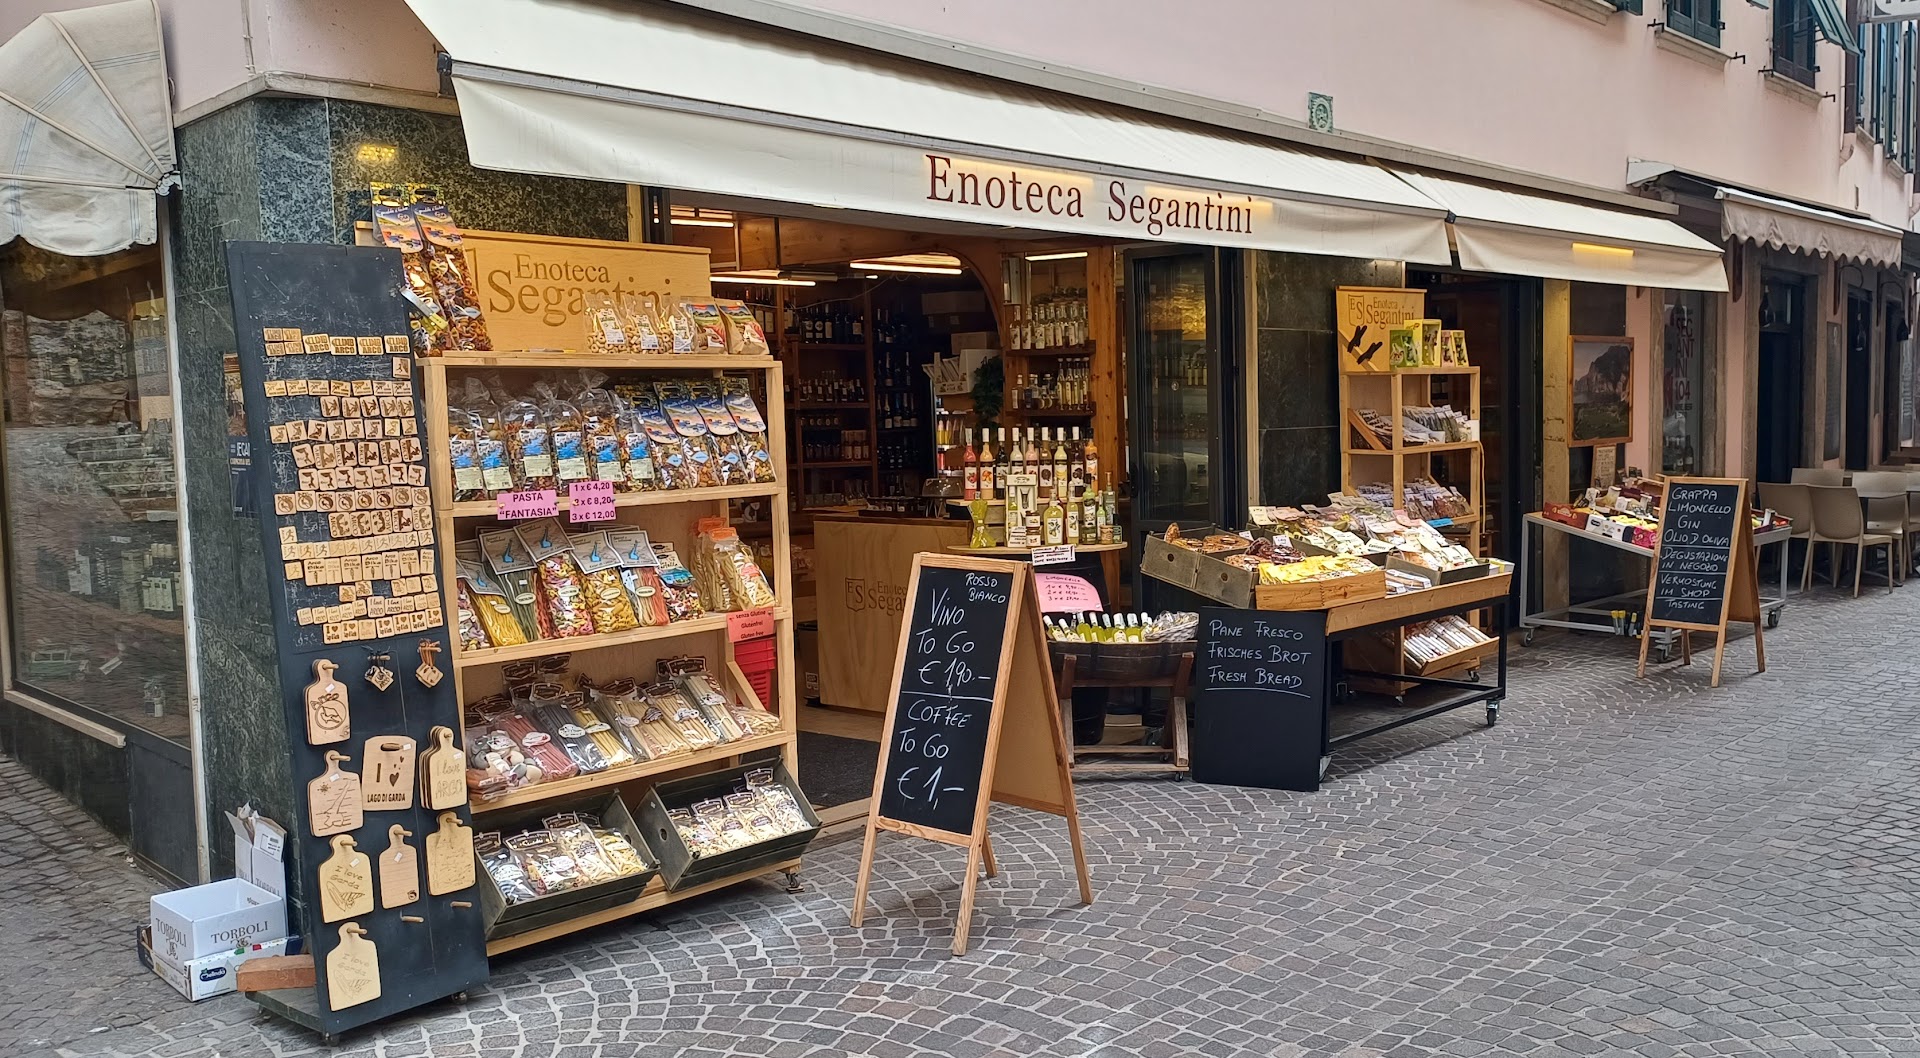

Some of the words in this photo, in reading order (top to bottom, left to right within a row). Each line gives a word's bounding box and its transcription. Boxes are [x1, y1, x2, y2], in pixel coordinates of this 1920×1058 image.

[925, 154, 1084, 218] Enoteca
[1108, 181, 1252, 236] Segantini
[514, 253, 611, 283] Enoteca
[487, 270, 671, 326] Segatn
[593, 482, 610, 491] 4,20
[1671, 487, 1717, 500] GRAPPA
[513, 492, 543, 502] PASTA
[593, 497, 611, 505] 8,20
[593, 511, 615, 519] 12,00
[1668, 501, 1731, 514] LIMONCELLO
[1678, 515, 1700, 529] GIN
[1701, 534, 1729, 547] OLIVA
[965, 572, 998, 587] ROSSO
[877, 581, 907, 596] Enotec
[968, 587, 1006, 604] BIANCO
[1681, 588, 1710, 598] SHOP
[931, 588, 965, 626] VINO
[1665, 599, 1704, 609] TASTING
[1209, 619, 1243, 637] PANE
[1254, 621, 1303, 640] FRESCO
[946, 630, 975, 654] GO
[1207, 641, 1262, 659] FRISCHES
[1267, 645, 1311, 665] BROT
[918, 660, 941, 685] €
[1208, 665, 1247, 683] FRESH
[1255, 668, 1302, 688] BREAD
[907, 699, 973, 728] COFFEE
[897, 766, 919, 800] €
[367, 794, 381, 803] LAGO
[388, 793, 406, 802] GARDA
[335, 865, 343, 873] I
[344, 868, 363, 881] love
[330, 874, 360, 890] Garda
[155, 918, 187, 948] TORBOLI
[211, 920, 269, 944] TORBOLI
[350, 956, 369, 967] love
